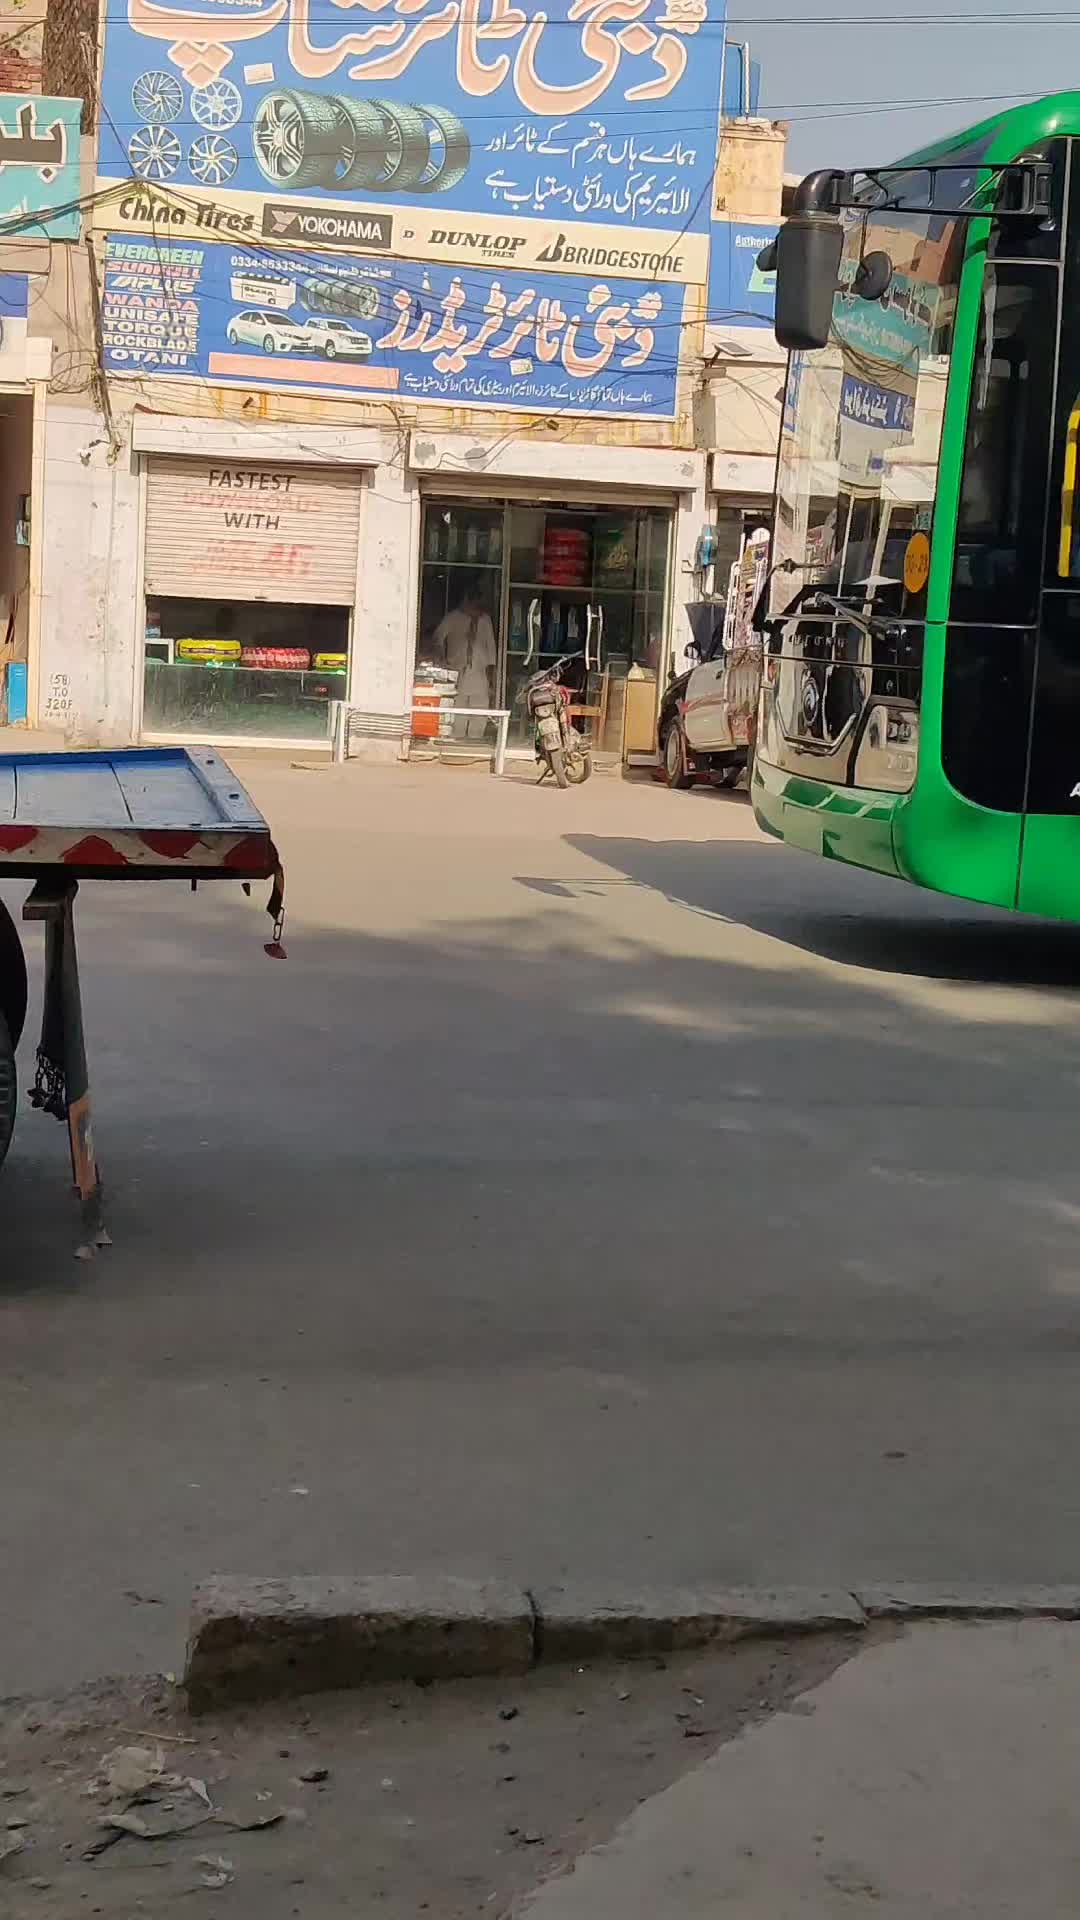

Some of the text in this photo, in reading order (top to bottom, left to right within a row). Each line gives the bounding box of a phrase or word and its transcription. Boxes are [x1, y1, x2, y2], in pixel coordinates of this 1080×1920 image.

[484, 130, 507, 151] اور
[537, 121, 569, 154] کے
[571, 121, 606, 168] قسم
[639, 140, 697, 166] ہمارے
[484, 169, 520, 199] ہے
[118, 197, 255, 232] China Tires
[298, 214, 383, 241] YOKOHAMA
[428, 229, 527, 250] DUNLOP
[106, 242, 204, 264] EVERGREEN
[563, 246, 685, 275] BRIDGESTONE
[105, 293, 199, 311] WANDA
[103, 320, 198, 337] TORQUE
[110, 348, 188, 366] OTANI
[208, 469, 297, 493] FASTEST
[223, 512, 281, 531] WITH
